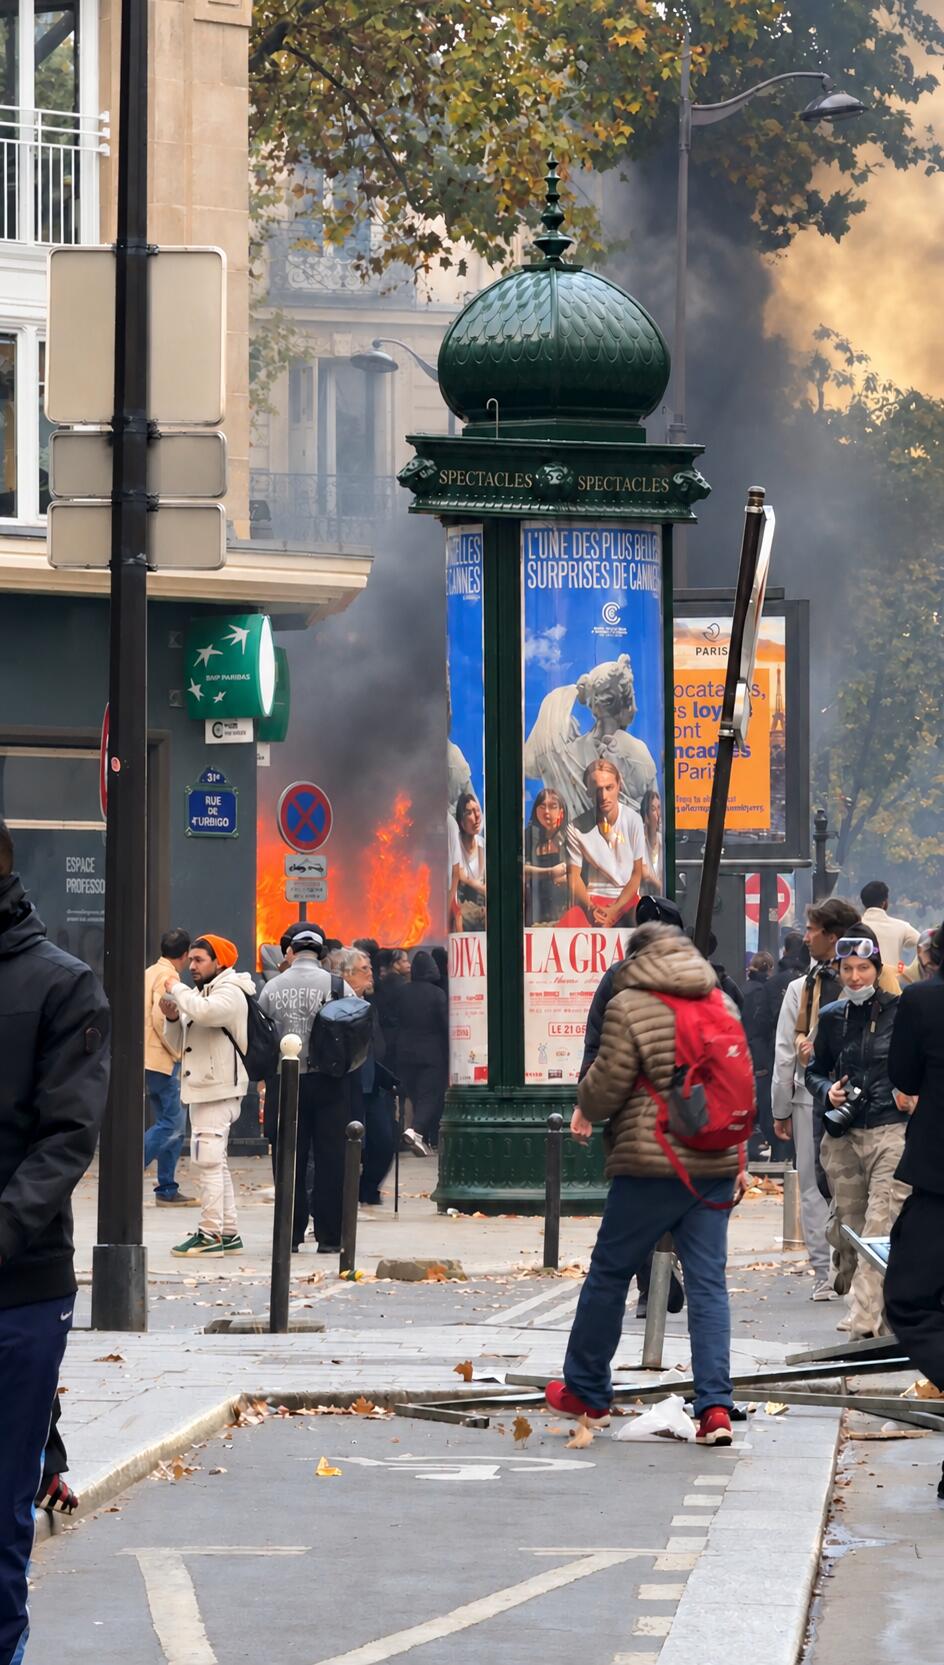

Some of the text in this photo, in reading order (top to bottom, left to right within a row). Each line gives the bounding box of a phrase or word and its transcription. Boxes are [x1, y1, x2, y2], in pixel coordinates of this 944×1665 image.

[439, 470, 533, 488] SPECTACLES
[578, 475, 669, 493] SPECTACLES
[528, 531, 658, 561] L'UNE DES PLUS BELLE
[527, 561, 658, 591] SURPRISES DE CANNE
[695, 647, 728, 656] PARIS
[221, 673, 251, 681] PARIBAS
[678, 762, 717, 780] Pari
[205, 795, 222, 806] RUE
[207, 807, 218, 815] DE
[66, 856, 96, 873] ESPACE
[450, 936, 486, 978] DIVA
[525, 932, 564, 973] LA
[551, 1025, 562, 1034] LE
[564, 1025, 573, 1034] 21
